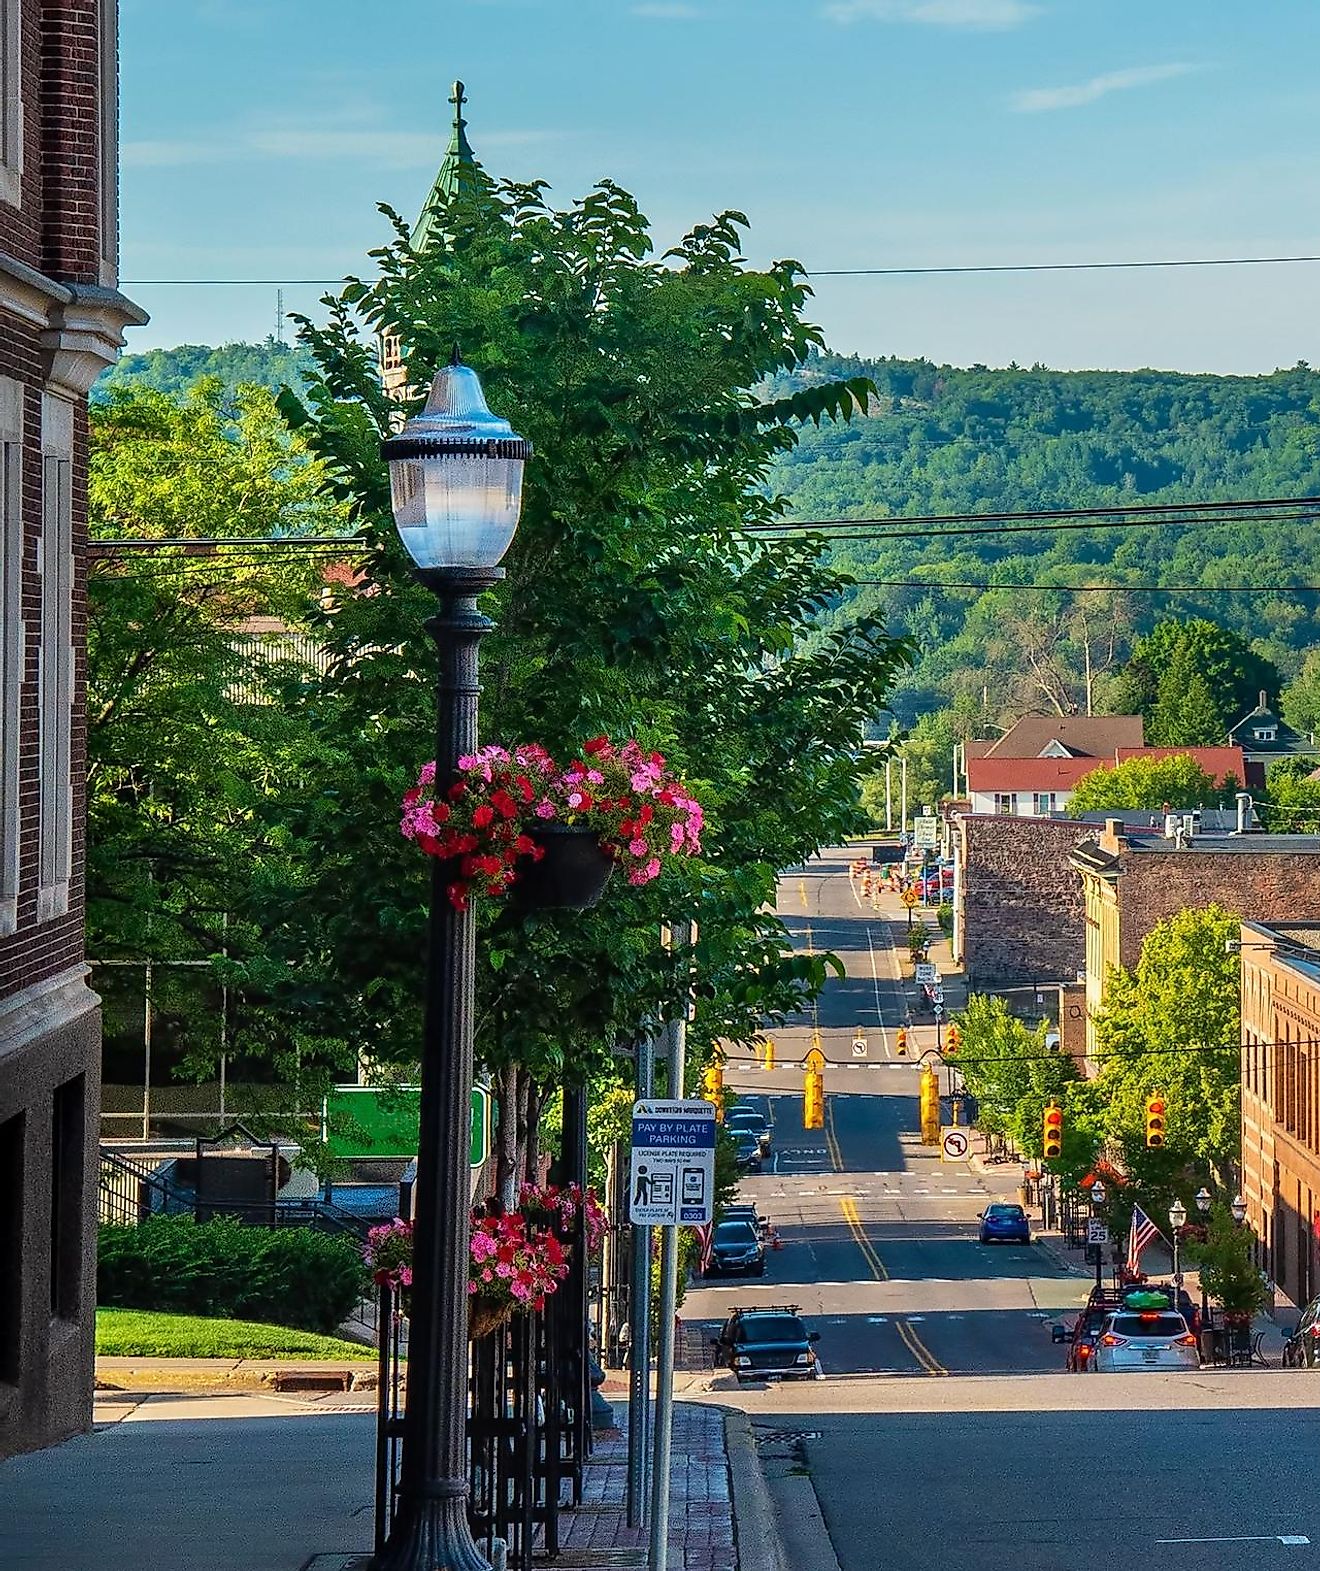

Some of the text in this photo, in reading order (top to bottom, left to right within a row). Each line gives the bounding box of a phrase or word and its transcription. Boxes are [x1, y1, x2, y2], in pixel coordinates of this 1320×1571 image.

[638, 1123, 708, 1134] PAY BY PLATE
[649, 1134, 697, 1144] PARKING
[678, 1150, 707, 1158] REQUIRED
[683, 1212, 703, 1220] 0303
[1090, 1231, 1106, 1241] 25
